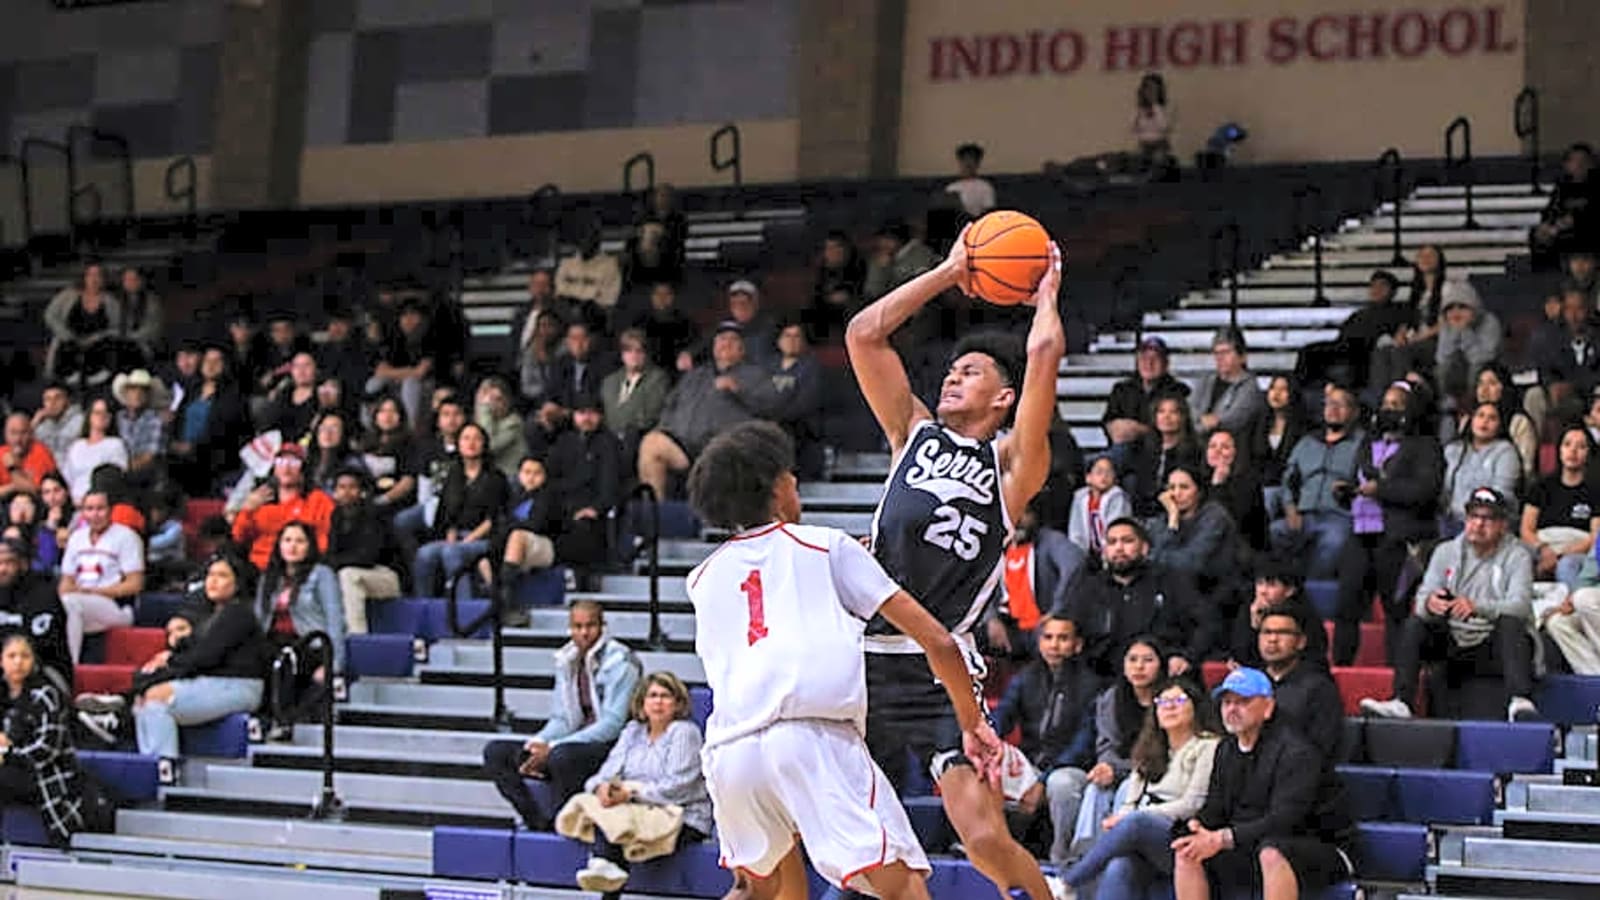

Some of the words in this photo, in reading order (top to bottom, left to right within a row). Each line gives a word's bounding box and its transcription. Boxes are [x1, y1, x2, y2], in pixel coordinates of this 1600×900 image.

[928, 30, 1088, 82] INDIO
[1104, 19, 1249, 70] HIGH
[1264, 6, 1518, 65] SCHOOL
[923, 505, 988, 561] 25
[740, 569, 769, 647] 1
